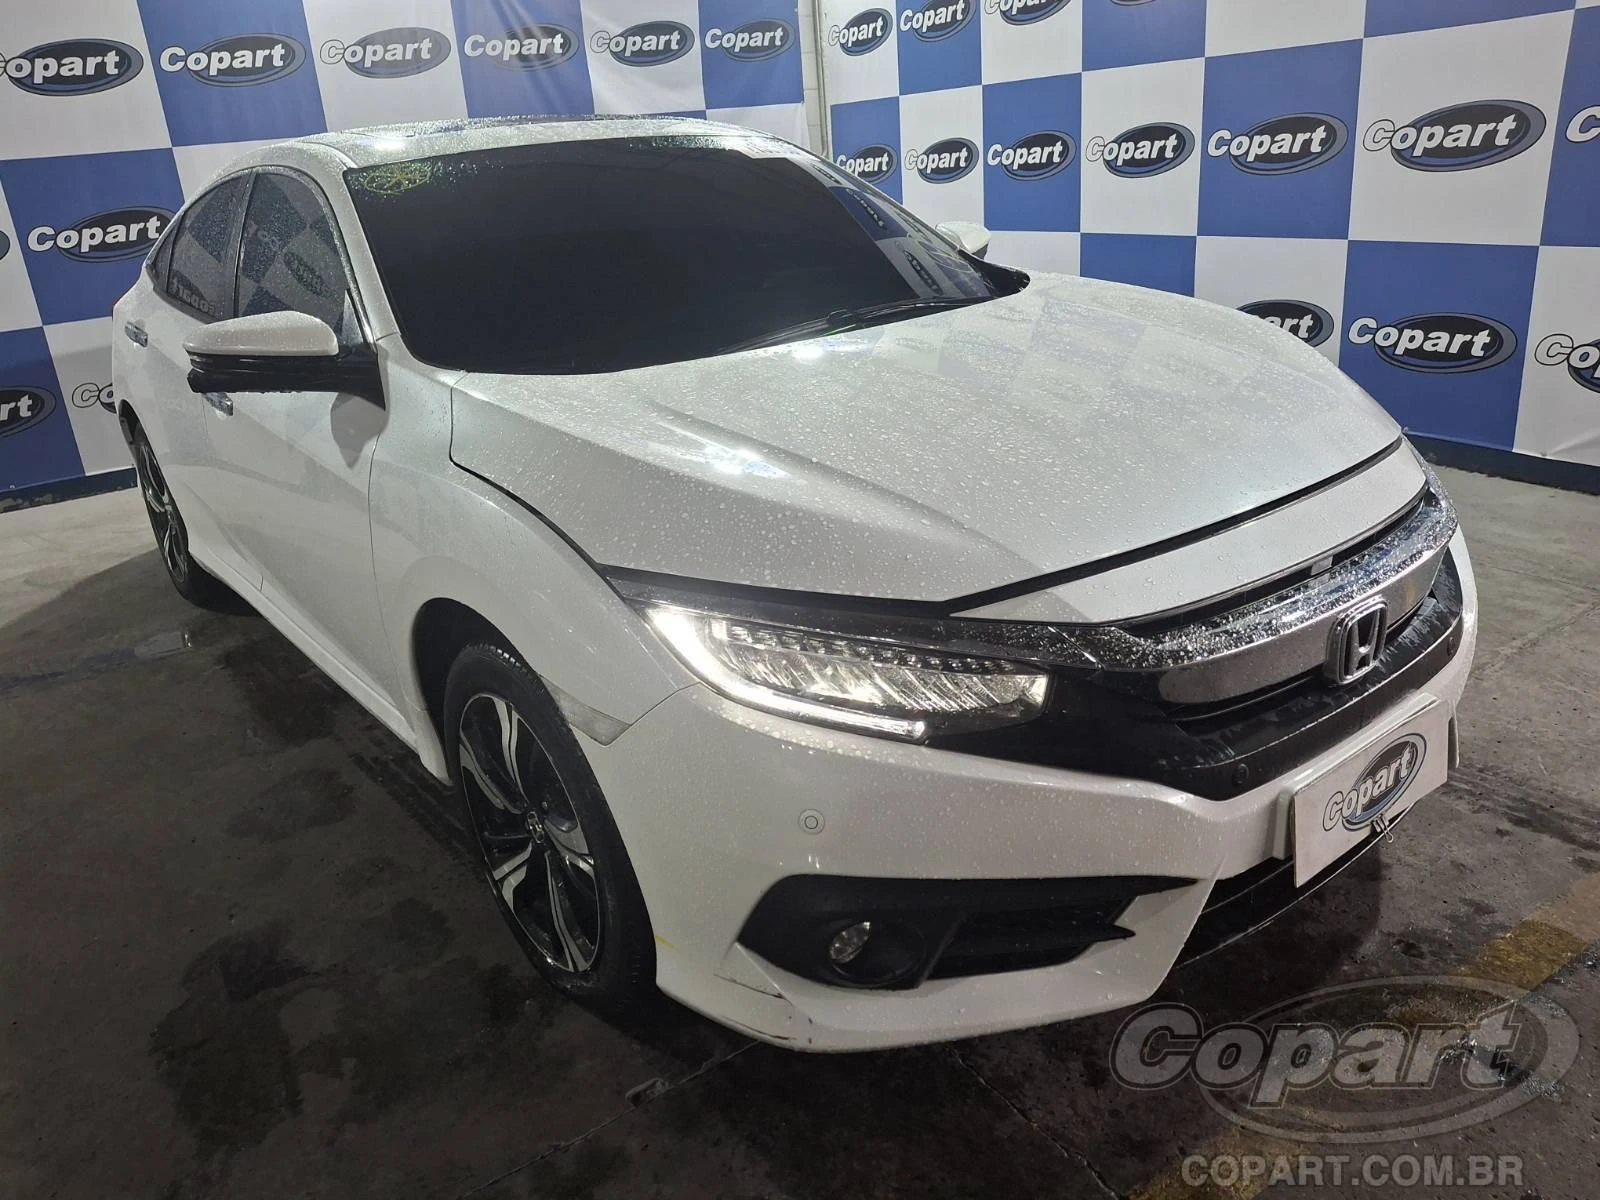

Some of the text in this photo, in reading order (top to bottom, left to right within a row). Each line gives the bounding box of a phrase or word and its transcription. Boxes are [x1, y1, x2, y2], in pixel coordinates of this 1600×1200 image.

[828, 16, 884, 48] Copart
[900, 0, 965, 33] Copart
[319, 37, 433, 68] Copart
[463, 33, 564, 61] Copart
[590, 30, 681, 57] Copart
[705, 26, 784, 52] Copart
[0, 50, 120, 85] opart
[159, 43, 286, 77] Copart
[1086, 133, 1178, 165] Copart
[1206, 125, 1327, 162] Copart
[1362, 114, 1517, 157] Copart
[836, 152, 889, 177] Copart
[905, 146, 969, 174] Copart
[987, 140, 1063, 168] Copart
[27, 215, 161, 252] Copart
[1348, 317, 1493, 357] Copart
[1323, 742, 1415, 831] Copart
